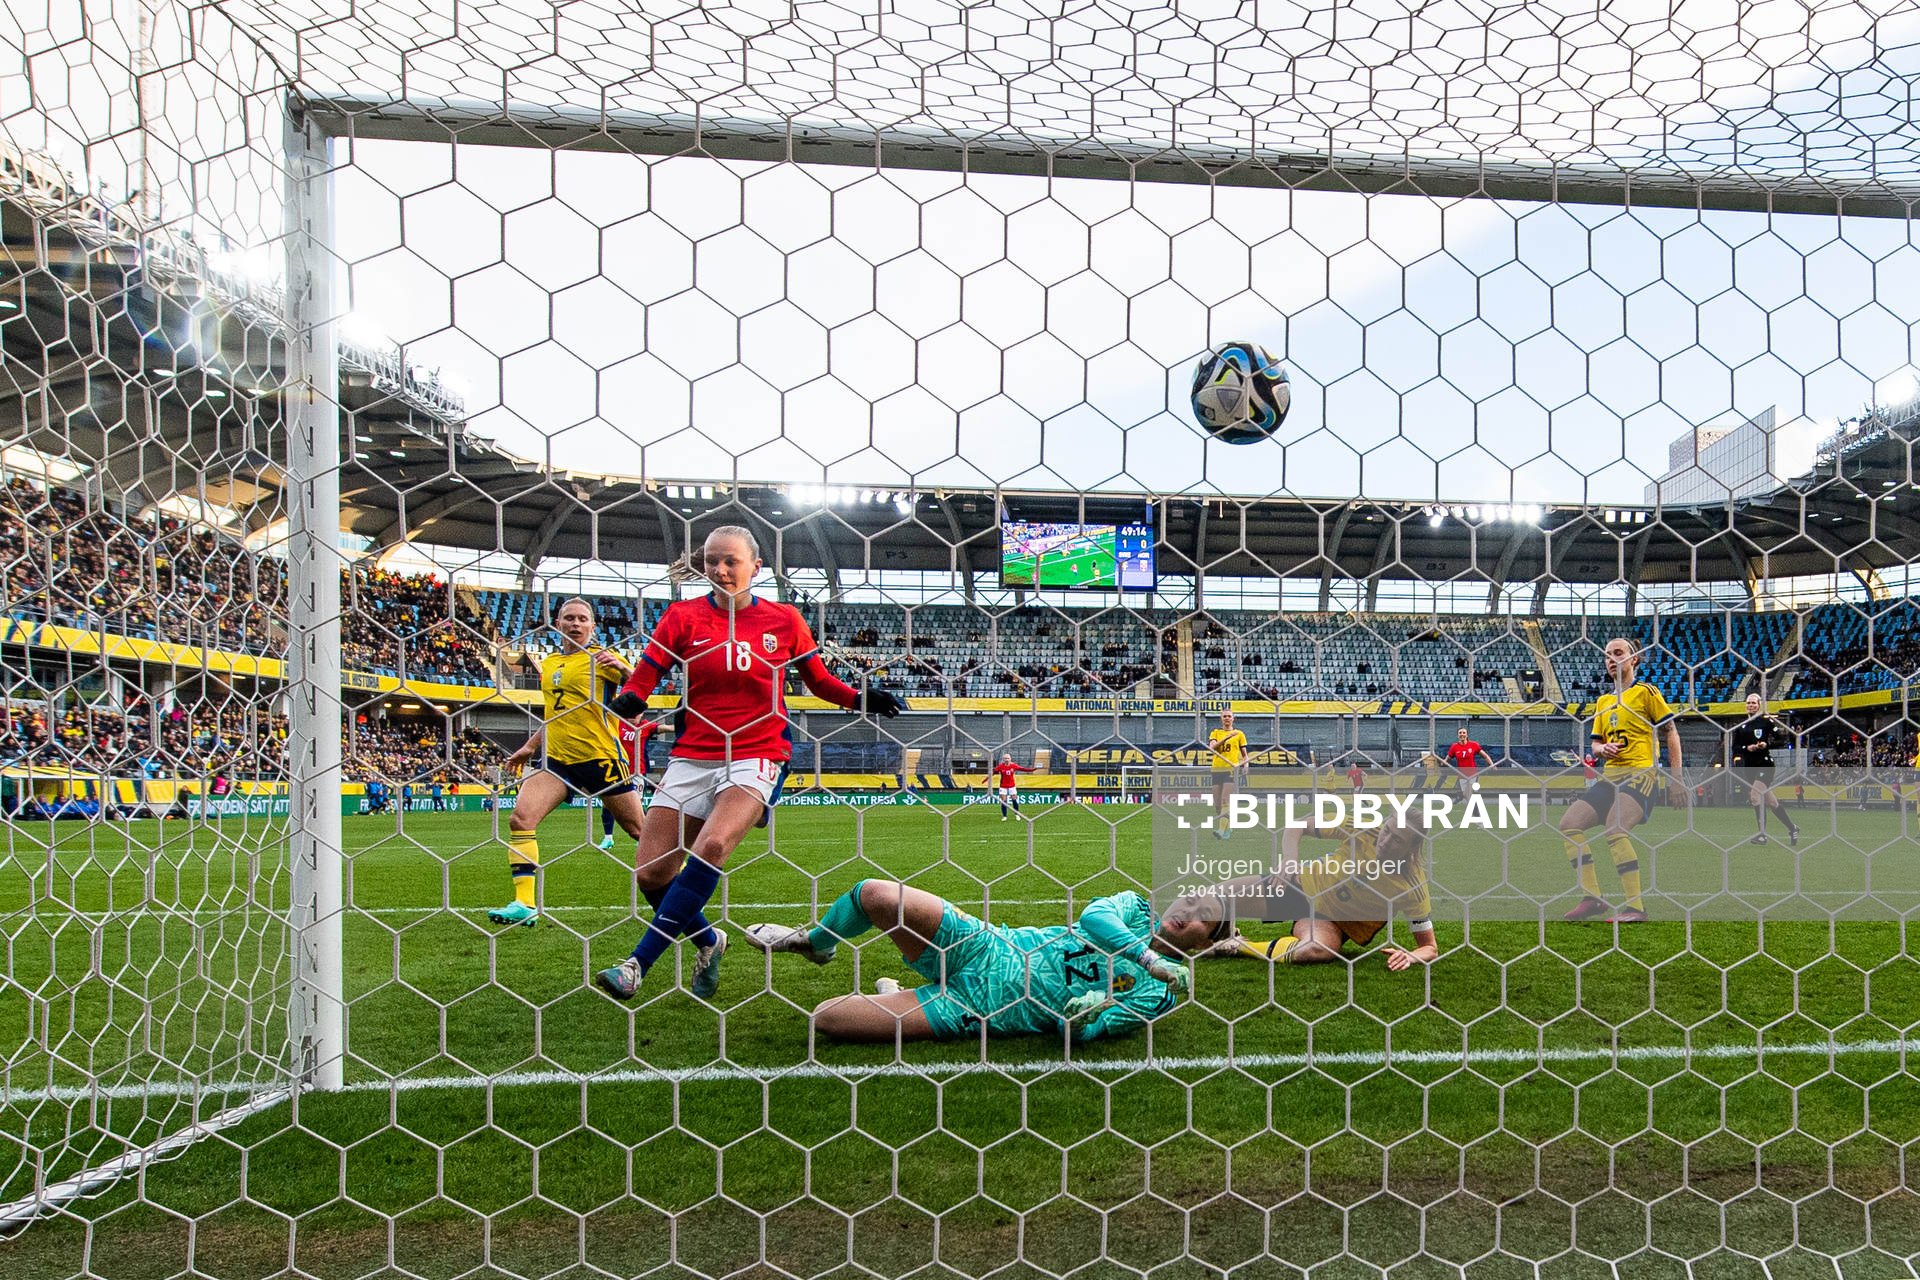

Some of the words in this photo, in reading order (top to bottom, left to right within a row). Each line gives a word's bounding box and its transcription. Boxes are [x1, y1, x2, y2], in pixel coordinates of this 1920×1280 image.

[1122, 539, 1128, 548] 1
[1140, 539, 1147, 549] 0
[725, 641, 751, 671] 18
[552, 688, 566, 711] 2
[1066, 700, 1154, 711] NATIONALRENAN
[623, 730, 636, 742] 20
[1065, 749, 1146, 764] HEJA
[1151, 749, 1298, 765] SVEGE!
[1461, 750, 1468, 758] 7
[598, 760, 619, 783] 2
[1097, 774, 1118, 787] HÄR
[826, 794, 849, 805] SÄTT
[851, 795, 867, 805] ATT
[871, 795, 897, 805] RESA
[1028, 792, 1053, 805] SÄTT
[1063, 944, 1100, 987] 12
